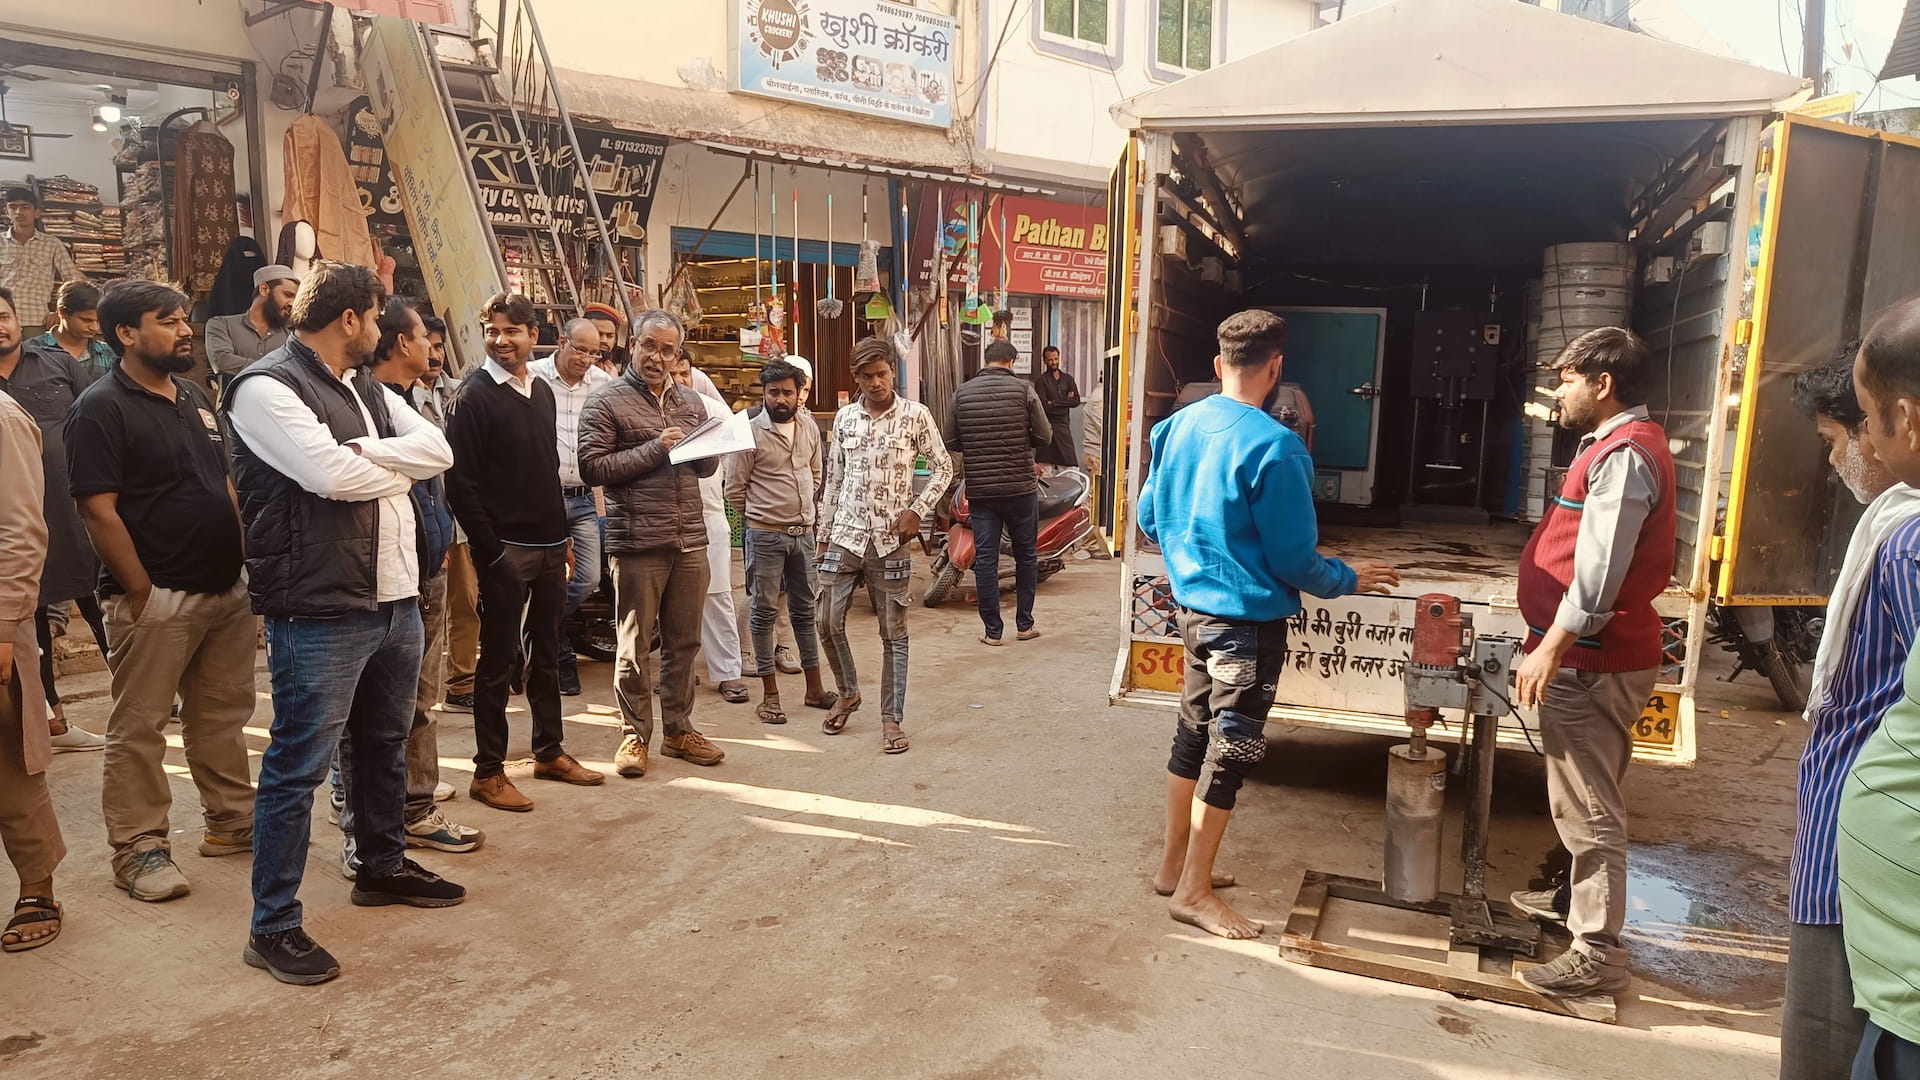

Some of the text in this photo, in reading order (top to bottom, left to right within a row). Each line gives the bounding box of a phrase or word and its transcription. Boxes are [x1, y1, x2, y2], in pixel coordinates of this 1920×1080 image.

[761, 8, 797, 28] KHUSHI
[820, 11, 949, 64] खुशी क्रॉकरी
[614, 140, 664, 156] 9713237513
[1012, 214, 1086, 250] Pathan
[1311, 608, 1332, 637] की
[1335, 611, 1364, 644] बुरी
[1365, 624, 1396, 646] नज़र
[1295, 641, 1316, 676] हो
[1318, 645, 1348, 678] बुरी
[1350, 655, 1387, 679] नज़र
[1629, 716, 1673, 740] 64
